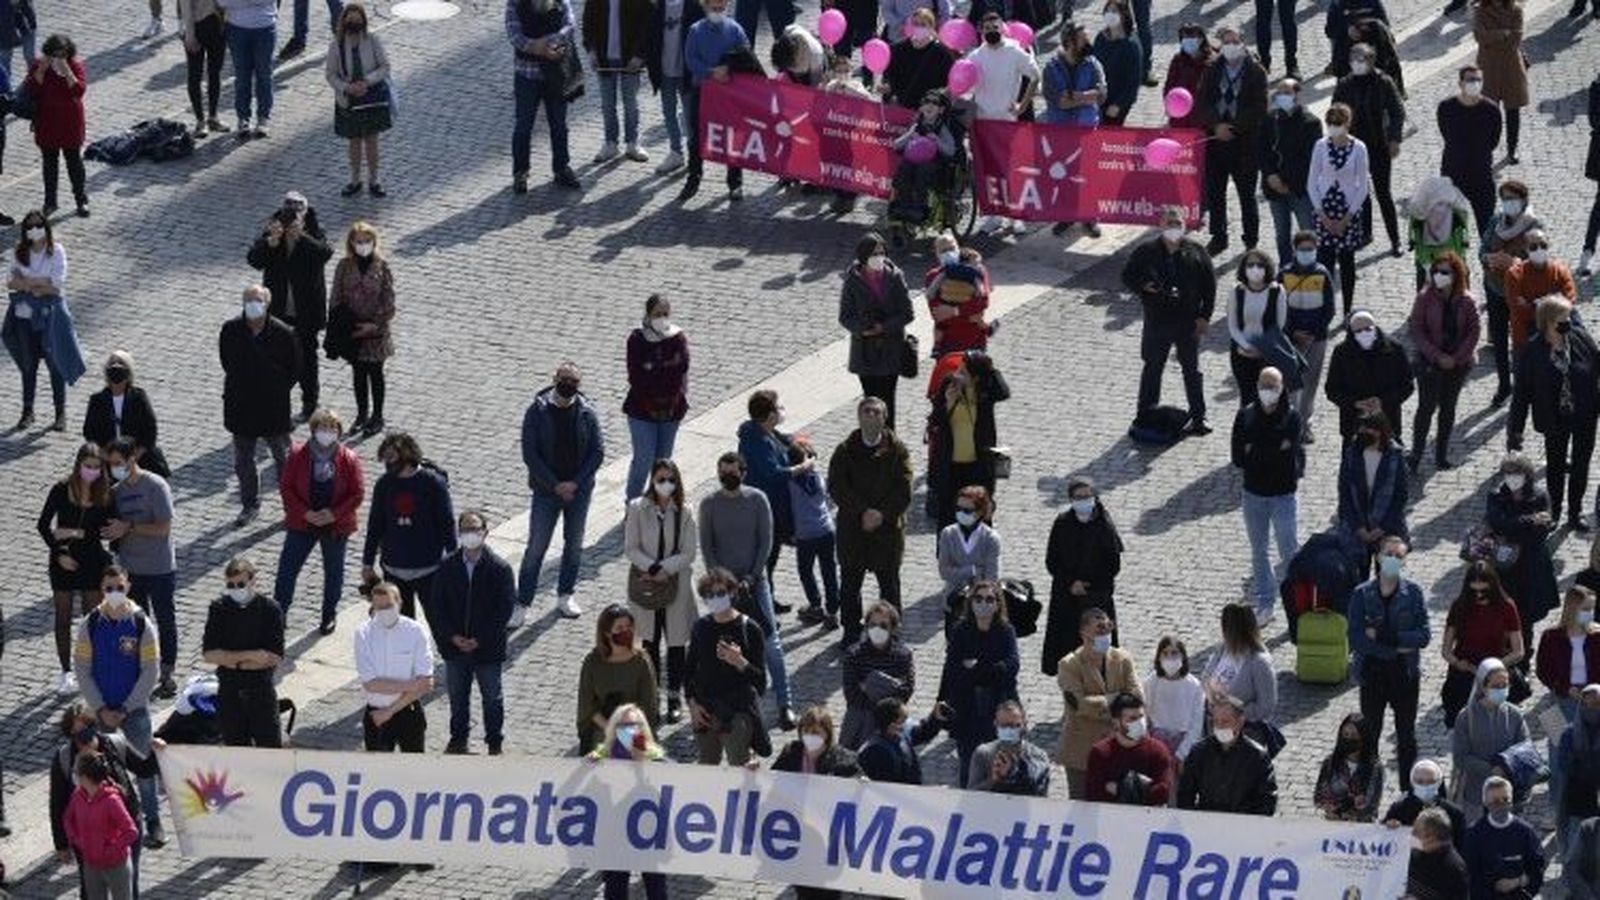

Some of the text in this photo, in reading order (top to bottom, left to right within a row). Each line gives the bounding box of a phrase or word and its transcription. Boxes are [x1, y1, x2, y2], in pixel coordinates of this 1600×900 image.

[707, 122, 766, 163] ELA
[820, 161, 893, 192] www.ela-as
[985, 175, 1043, 212] ELA
[281, 769, 1299, 900] Giornata delle Malattie Rare
